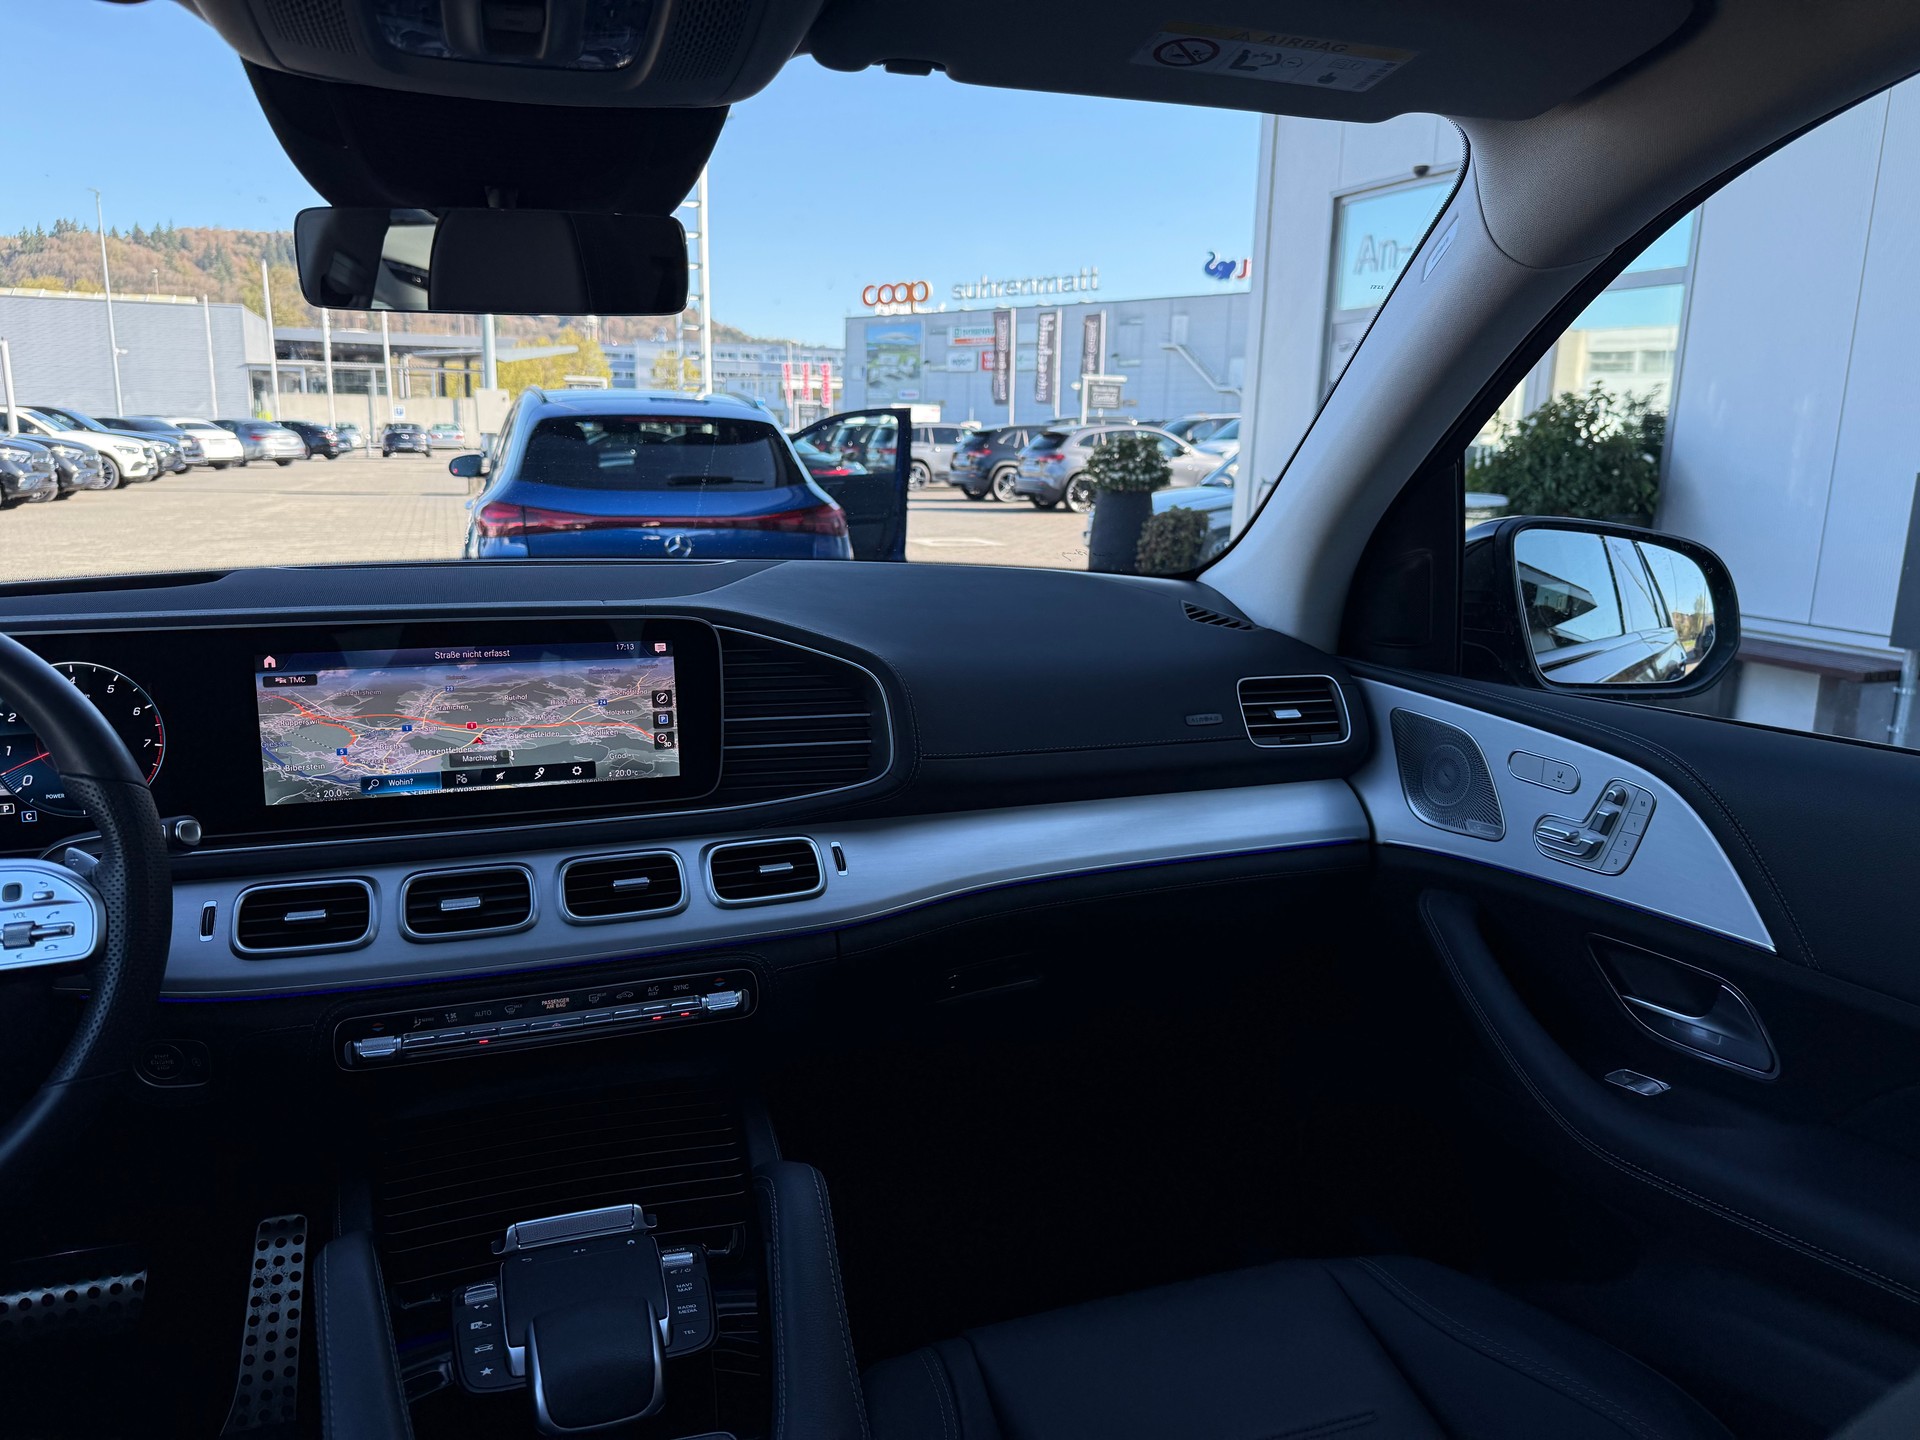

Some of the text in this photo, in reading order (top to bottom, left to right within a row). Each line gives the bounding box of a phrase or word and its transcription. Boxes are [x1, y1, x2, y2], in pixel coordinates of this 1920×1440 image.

[1261, 34, 1350, 53] AIRBAG
[862, 280, 931, 314] coop
[952, 265, 1099, 300] suhrenmatt
[616, 643, 635, 651] 17:13
[434, 649, 511, 660] Straße nicht erfasst
[288, 676, 307, 684] TMC
[106, 684, 115, 694] 5
[132, 706, 142, 716] 6
[7, 712, 17, 723] 2
[143, 738, 152, 748] 7
[5, 745, 12, 757] 1
[462, 753, 498, 763] Marchweg
[285, 763, 326, 772] Biberstein
[22, 774, 34, 786] 0
[388, 777, 414, 787] Wohin?
[3, 805, 10, 813] P
[25, 812, 33, 821] C
[13, 911, 27, 920] VOL
[647, 985, 660, 993] A/C
[673, 983, 690, 992] SYNC
[541, 997, 570, 1006] PASSENGER
[474, 1009, 492, 1018] AUTO
